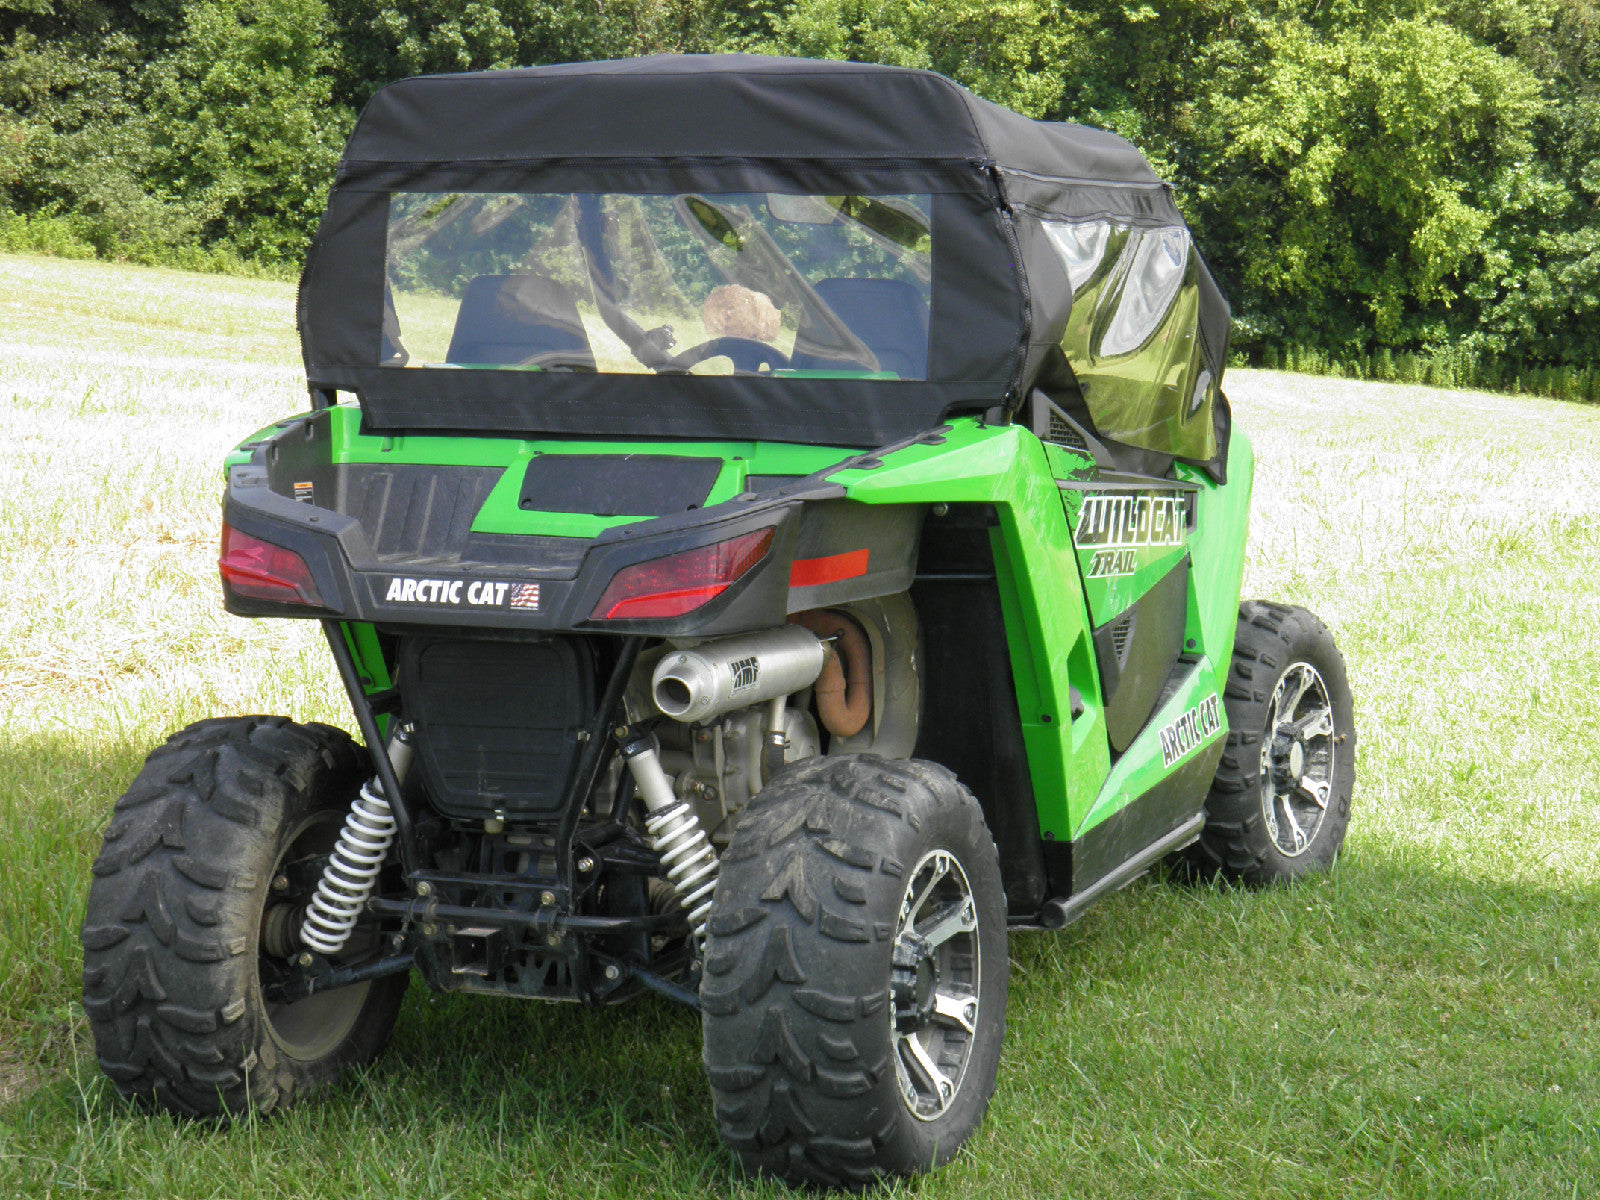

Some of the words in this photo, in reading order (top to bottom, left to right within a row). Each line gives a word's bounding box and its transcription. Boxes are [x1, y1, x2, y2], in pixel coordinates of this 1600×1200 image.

[1074, 496, 1186, 549] WILDCAT
[1086, 549, 1138, 578] TRAIL
[386, 578, 463, 604] ARCTIC
[467, 581, 509, 605] CAT
[1158, 706, 1202, 769] ARCTIC
[1199, 692, 1221, 737] CAT
